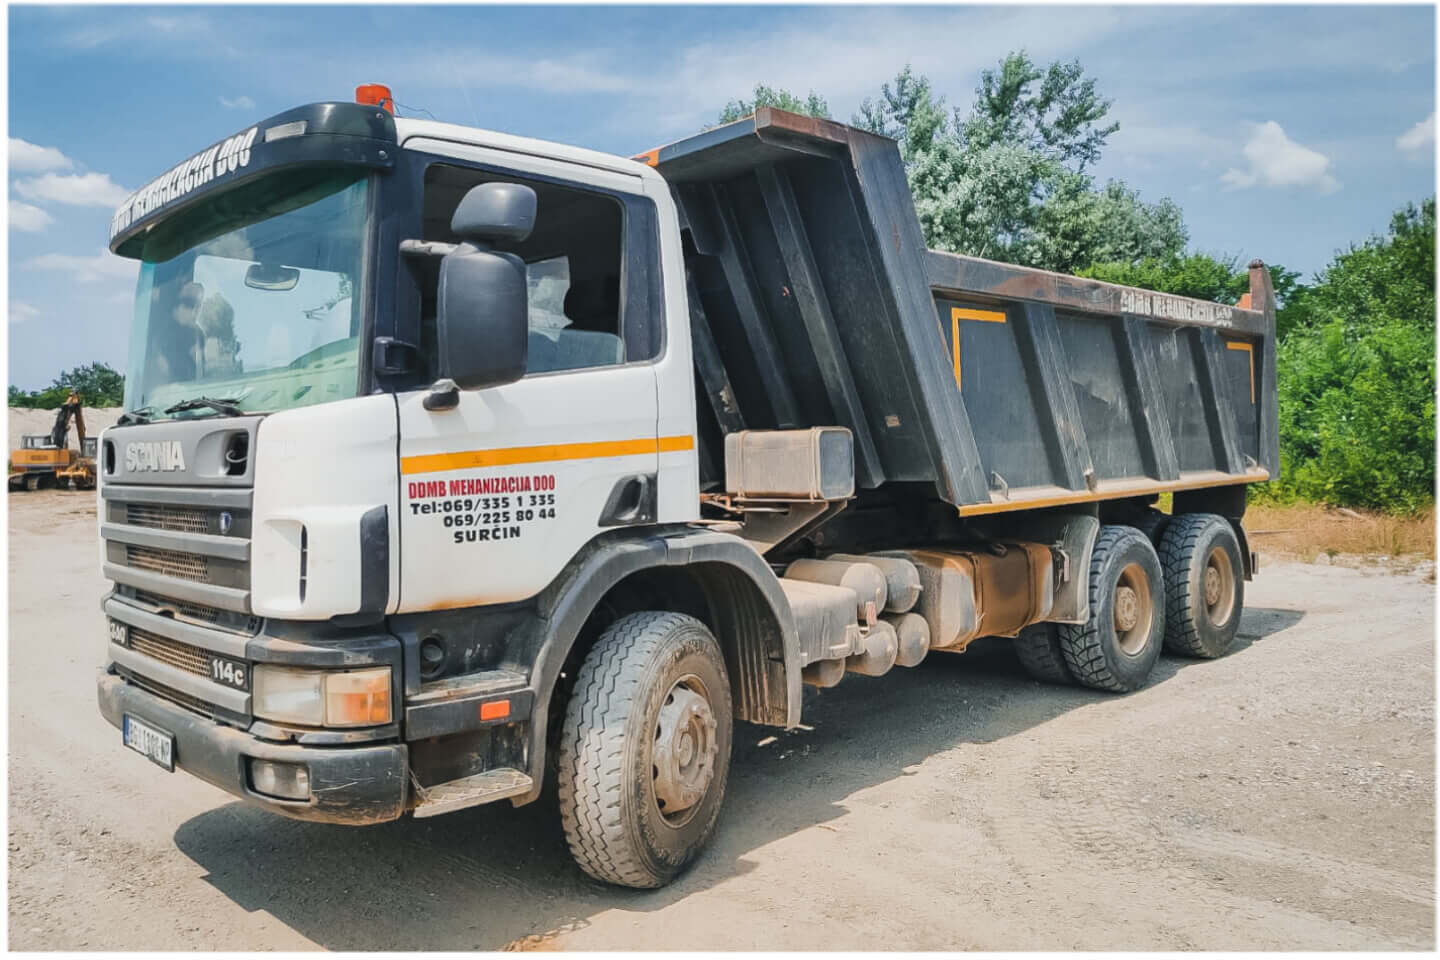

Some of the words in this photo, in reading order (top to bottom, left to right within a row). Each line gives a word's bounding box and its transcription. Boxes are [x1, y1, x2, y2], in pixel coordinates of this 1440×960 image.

[216, 127, 258, 177] DOO
[125, 439, 186, 472] SCANIA
[408, 480, 447, 499] DDMB
[449, 476, 532, 496] MEHANIZACIJA
[533, 474, 556, 491] DOO
[410, 497, 510, 515] Tel:069/335
[516, 496, 523, 507] 1
[529, 494, 556, 507] 335
[443, 511, 511, 527] 069/225
[516, 509, 534, 522] 80
[538, 508, 556, 519] 44
[454, 525, 521, 543] SURČIN
